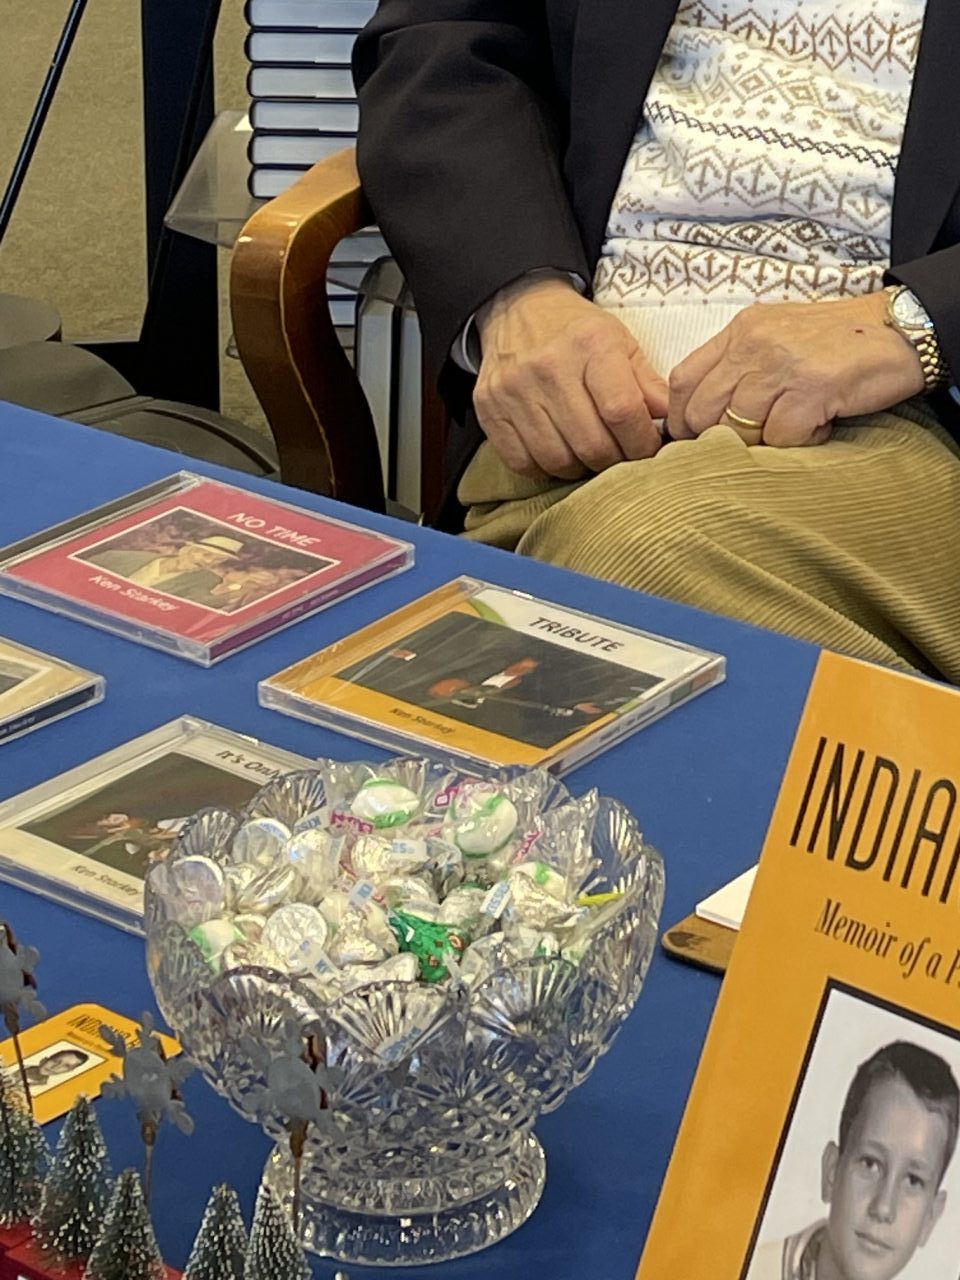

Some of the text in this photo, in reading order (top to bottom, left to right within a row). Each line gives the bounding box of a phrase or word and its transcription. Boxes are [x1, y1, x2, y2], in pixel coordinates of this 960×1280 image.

[227, 512, 322, 548] NO TIME
[87, 574, 180, 613] Ken Starkey
[528, 616, 626, 654] TRIBUTE
[389, 707, 456, 734] Ken Starkey
[215, 749, 246, 765] It's
[71, 864, 142, 896] Ken Starkey
[814, 897, 899, 960] Memoir
[898, 935, 927, 982] of
[926, 954, 942, 981] a
